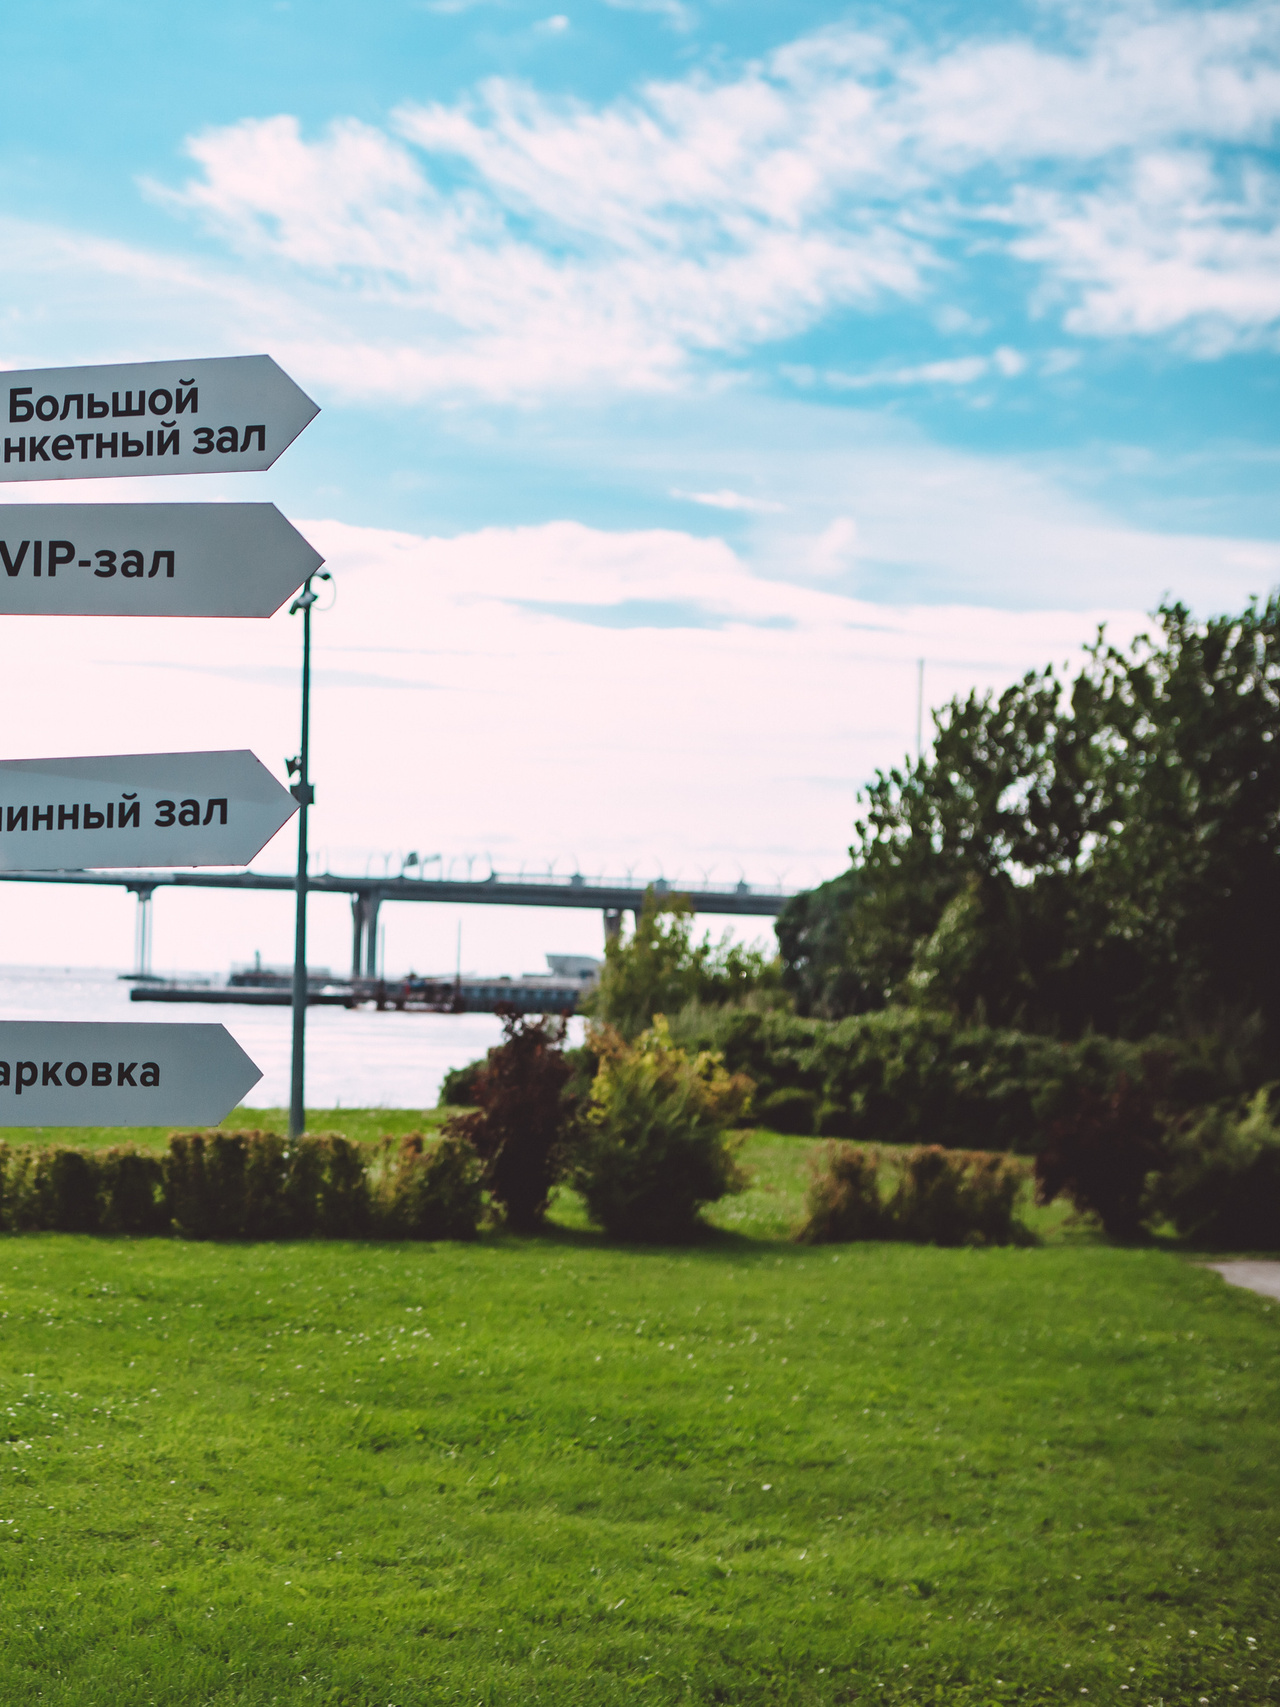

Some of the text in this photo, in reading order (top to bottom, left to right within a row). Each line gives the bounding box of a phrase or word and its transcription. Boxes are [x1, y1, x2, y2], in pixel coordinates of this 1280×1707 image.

[9, 377, 199, 424] Большой
[192, 424, 266, 455] зал
[154, 797, 228, 828] зал
